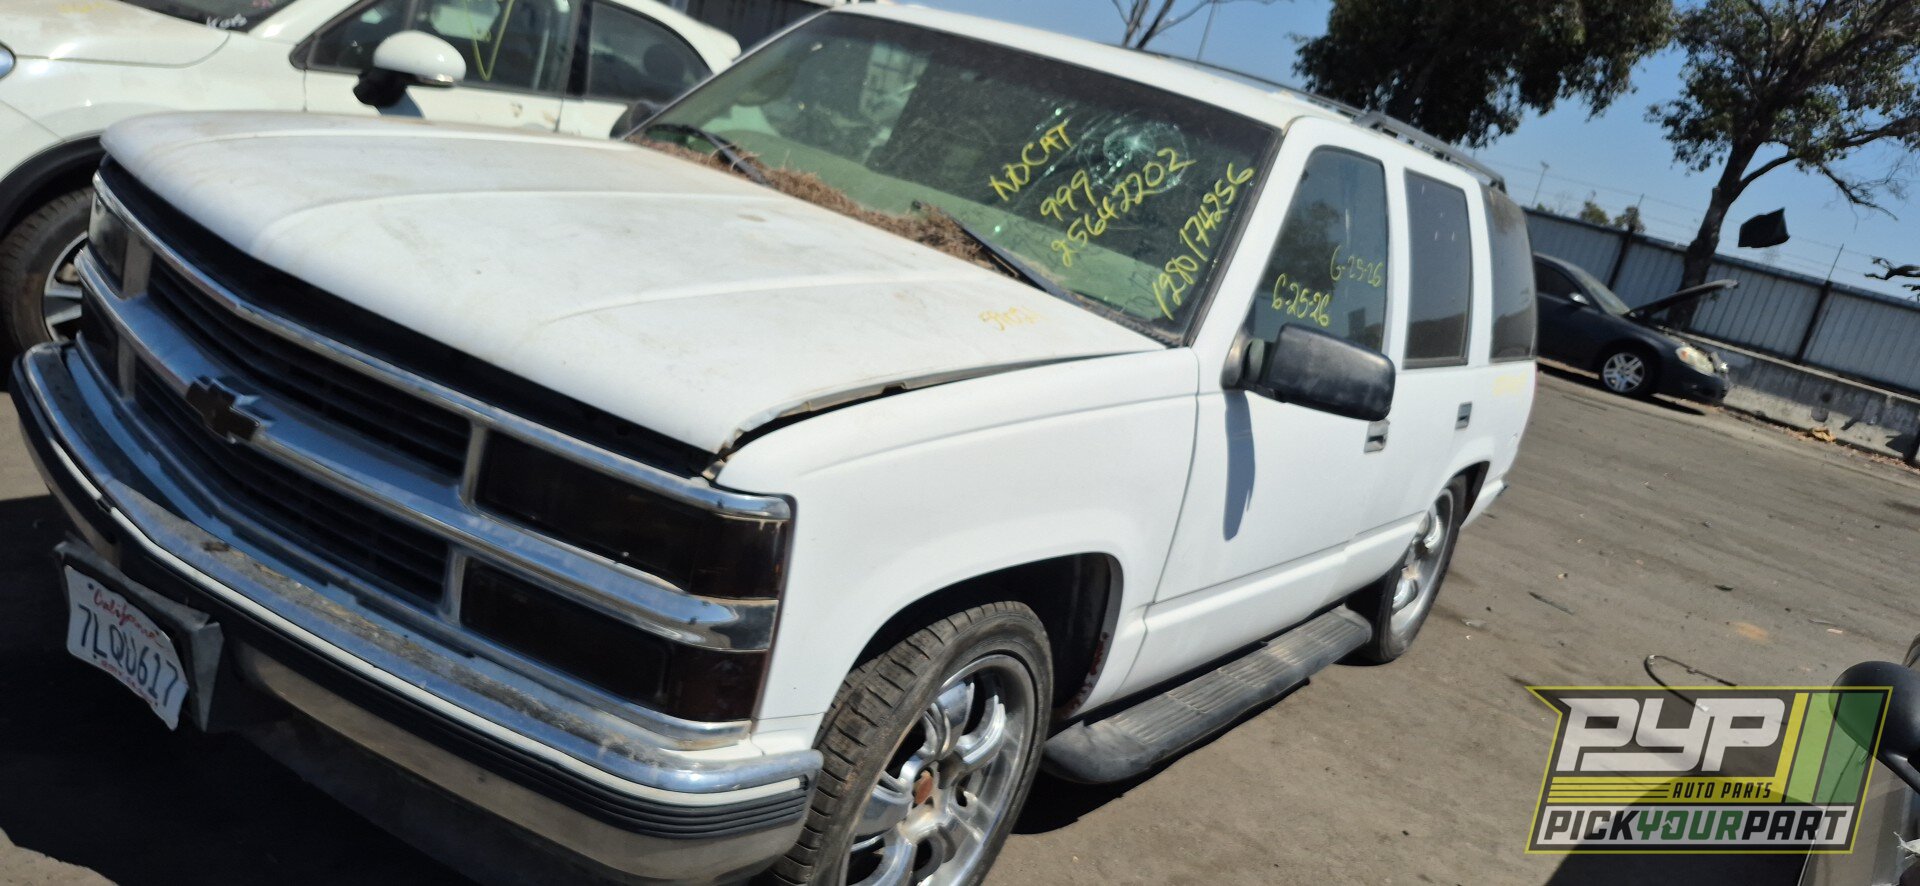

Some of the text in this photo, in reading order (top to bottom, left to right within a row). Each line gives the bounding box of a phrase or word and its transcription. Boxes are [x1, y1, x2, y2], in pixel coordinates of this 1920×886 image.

[1040, 169, 1097, 222] 999
[1272, 273, 1330, 327] 6-25-26
[78, 603, 179, 706] 7LQU617
